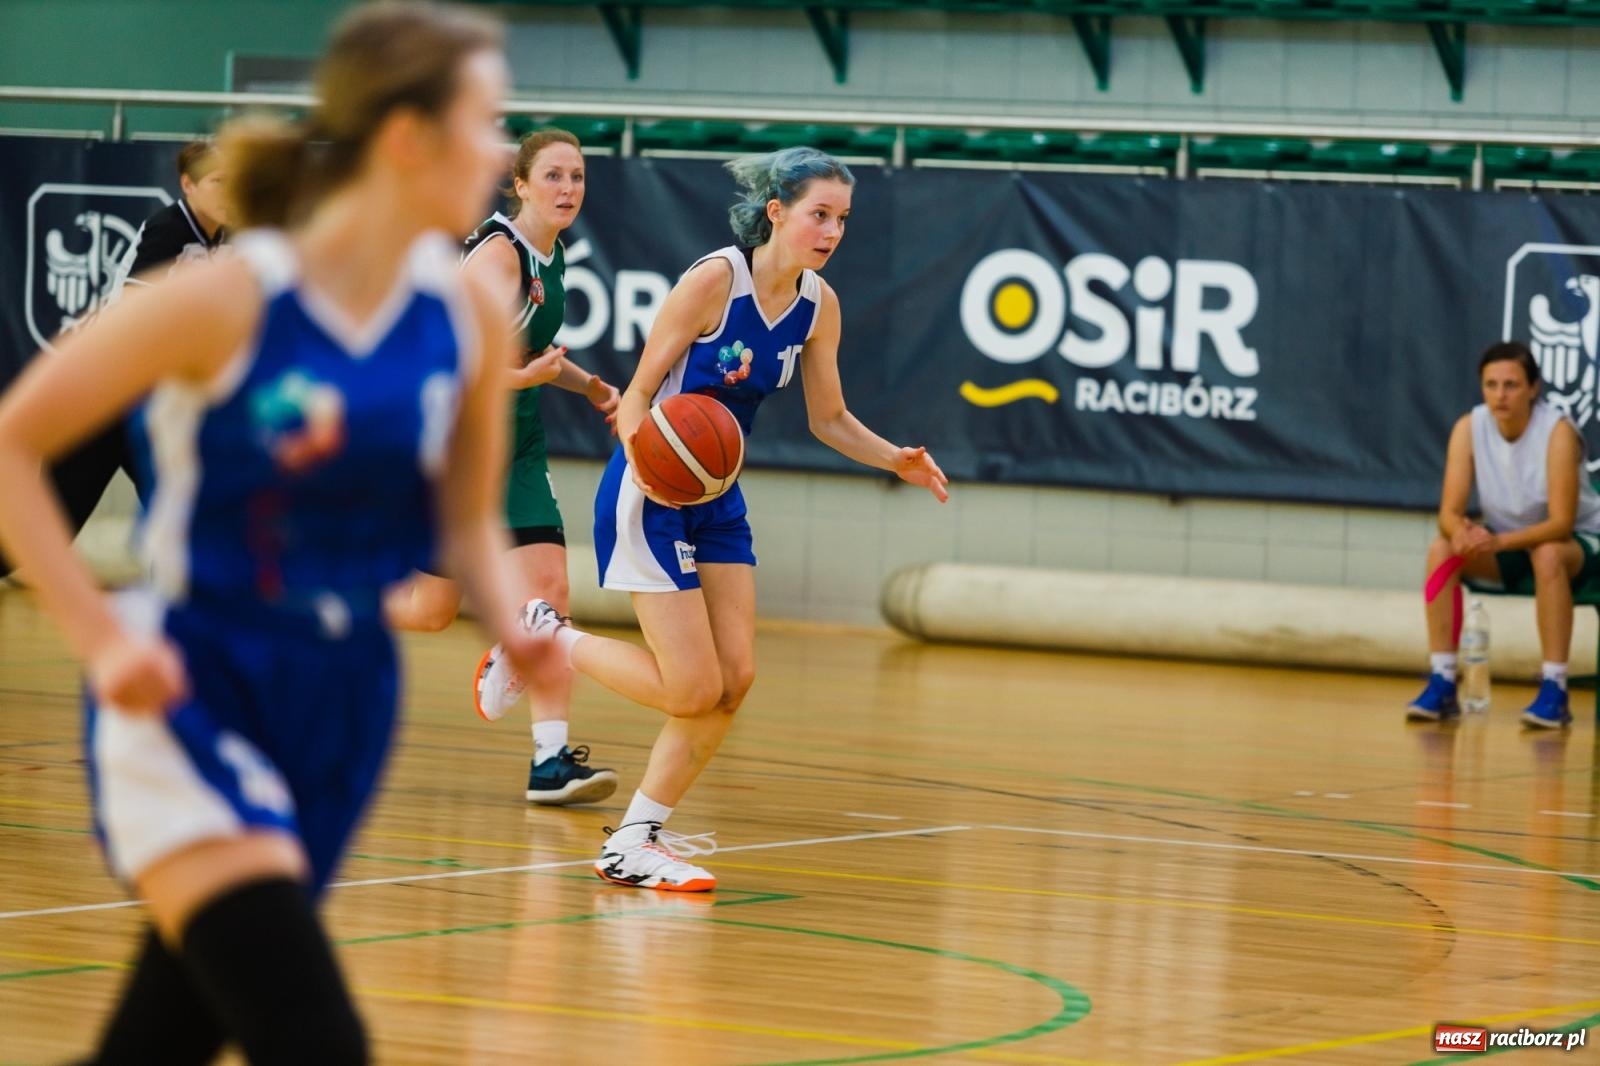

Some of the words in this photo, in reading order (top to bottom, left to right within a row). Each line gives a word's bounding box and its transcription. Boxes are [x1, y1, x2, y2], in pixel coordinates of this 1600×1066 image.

[552, 238, 680, 352] ÓR
[960, 248, 1259, 377] OSiR
[1075, 376, 1257, 420] RACIBÓRZ
